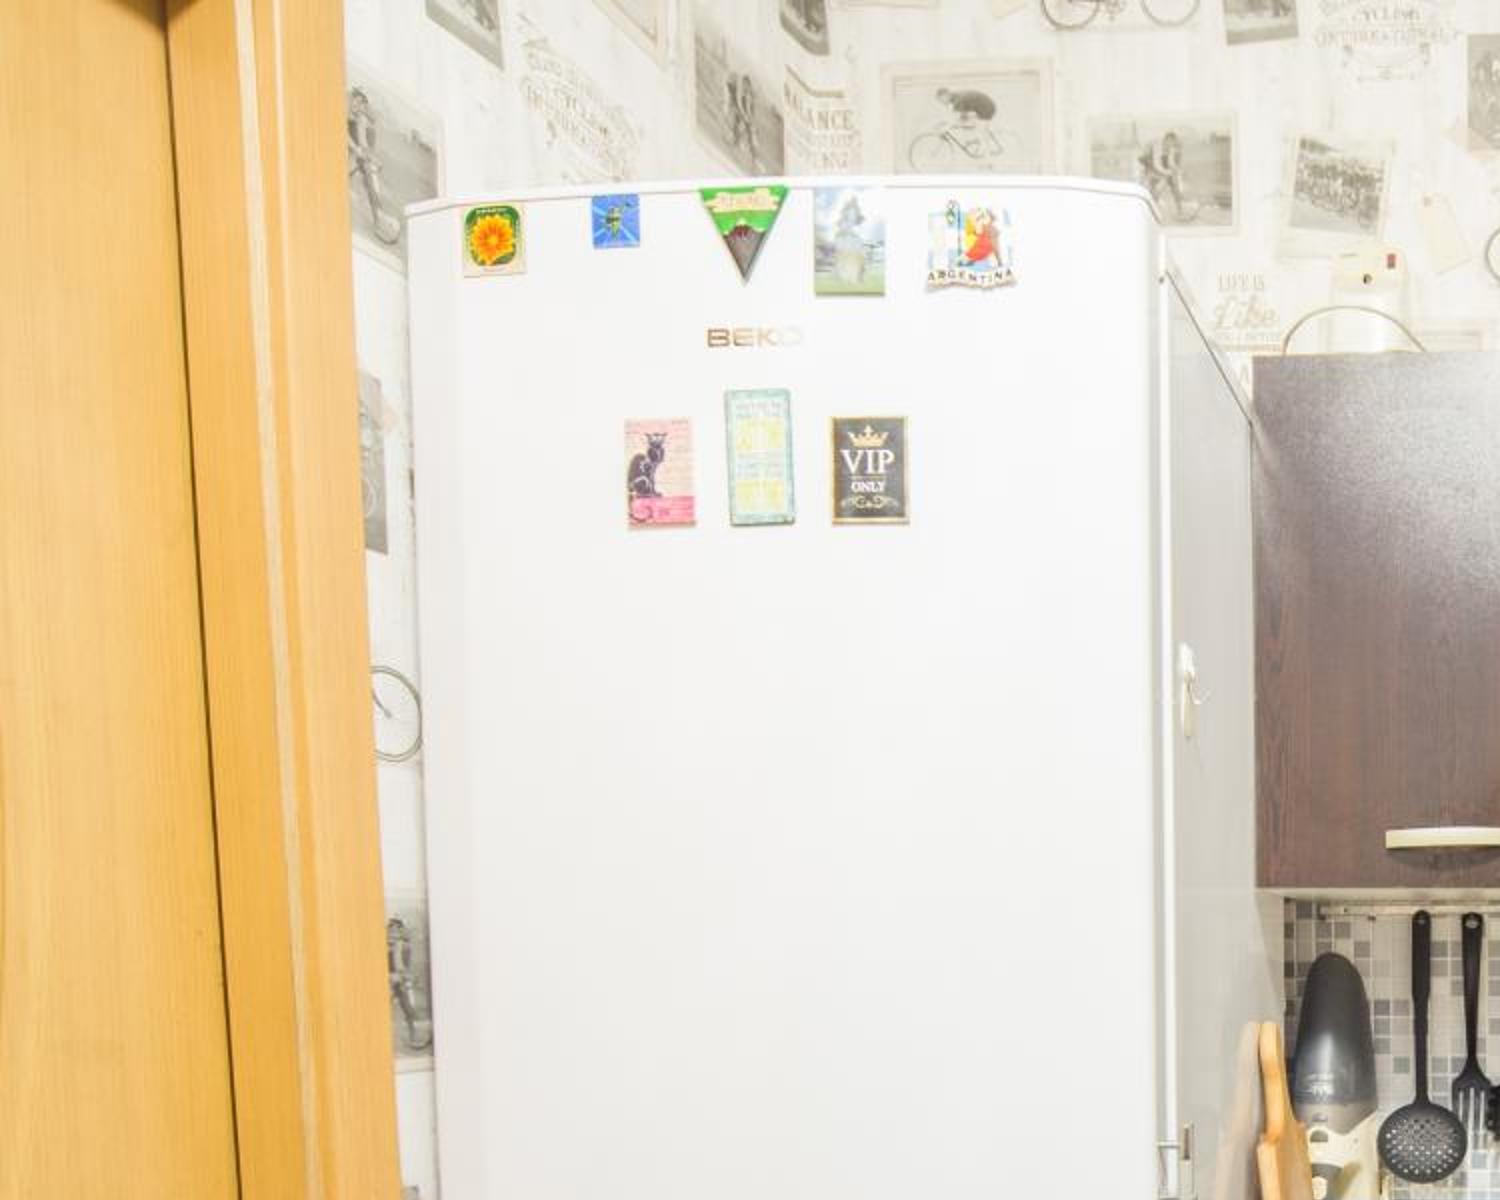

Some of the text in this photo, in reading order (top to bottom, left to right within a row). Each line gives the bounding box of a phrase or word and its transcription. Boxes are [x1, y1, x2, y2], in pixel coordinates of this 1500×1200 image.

[927, 268, 1013, 284] ARGENTINA
[841, 448, 896, 475] VIP
[851, 480, 885, 494] ONLY
